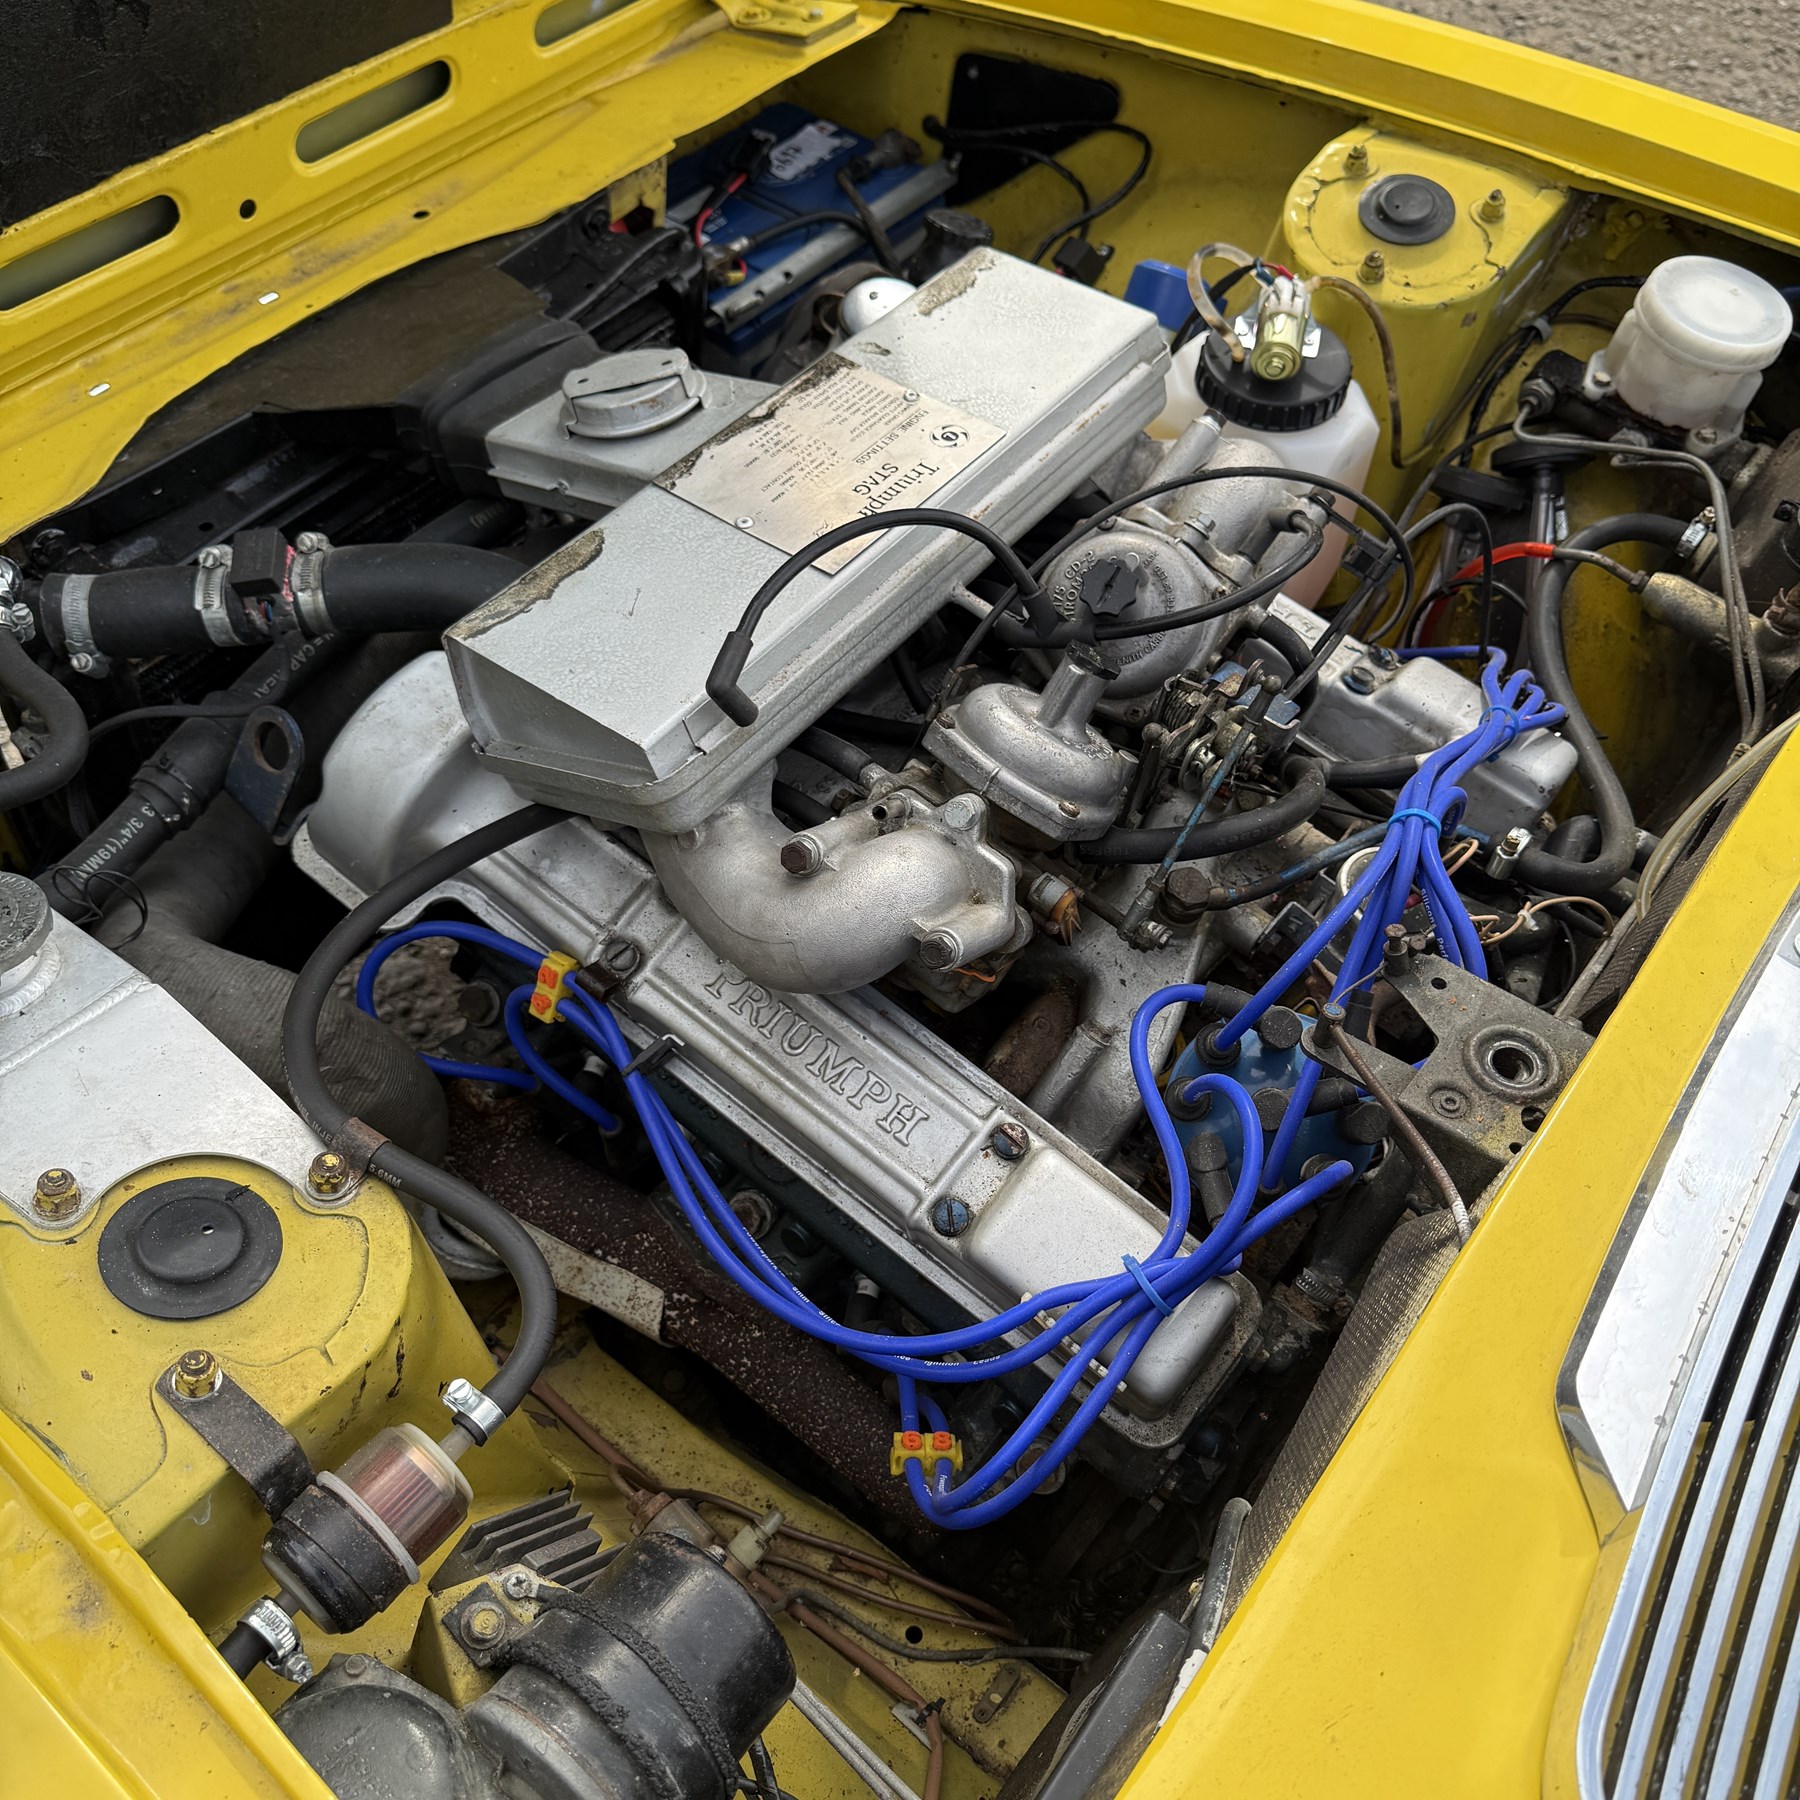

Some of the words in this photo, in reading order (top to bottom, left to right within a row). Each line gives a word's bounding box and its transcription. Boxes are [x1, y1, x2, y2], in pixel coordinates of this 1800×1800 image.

[895, 409, 929, 433] ENGINE
[854, 432, 899, 465] SETTINGS
[850, 461, 899, 496] STAG
[856, 460, 939, 520] Triumph
[1065, 550, 1095, 579] CD-2
[1113, 650, 1143, 667] ENITH
[704, 971, 931, 1148] TRIUMPH
[369, 1163, 402, 1188] 5.6MM
